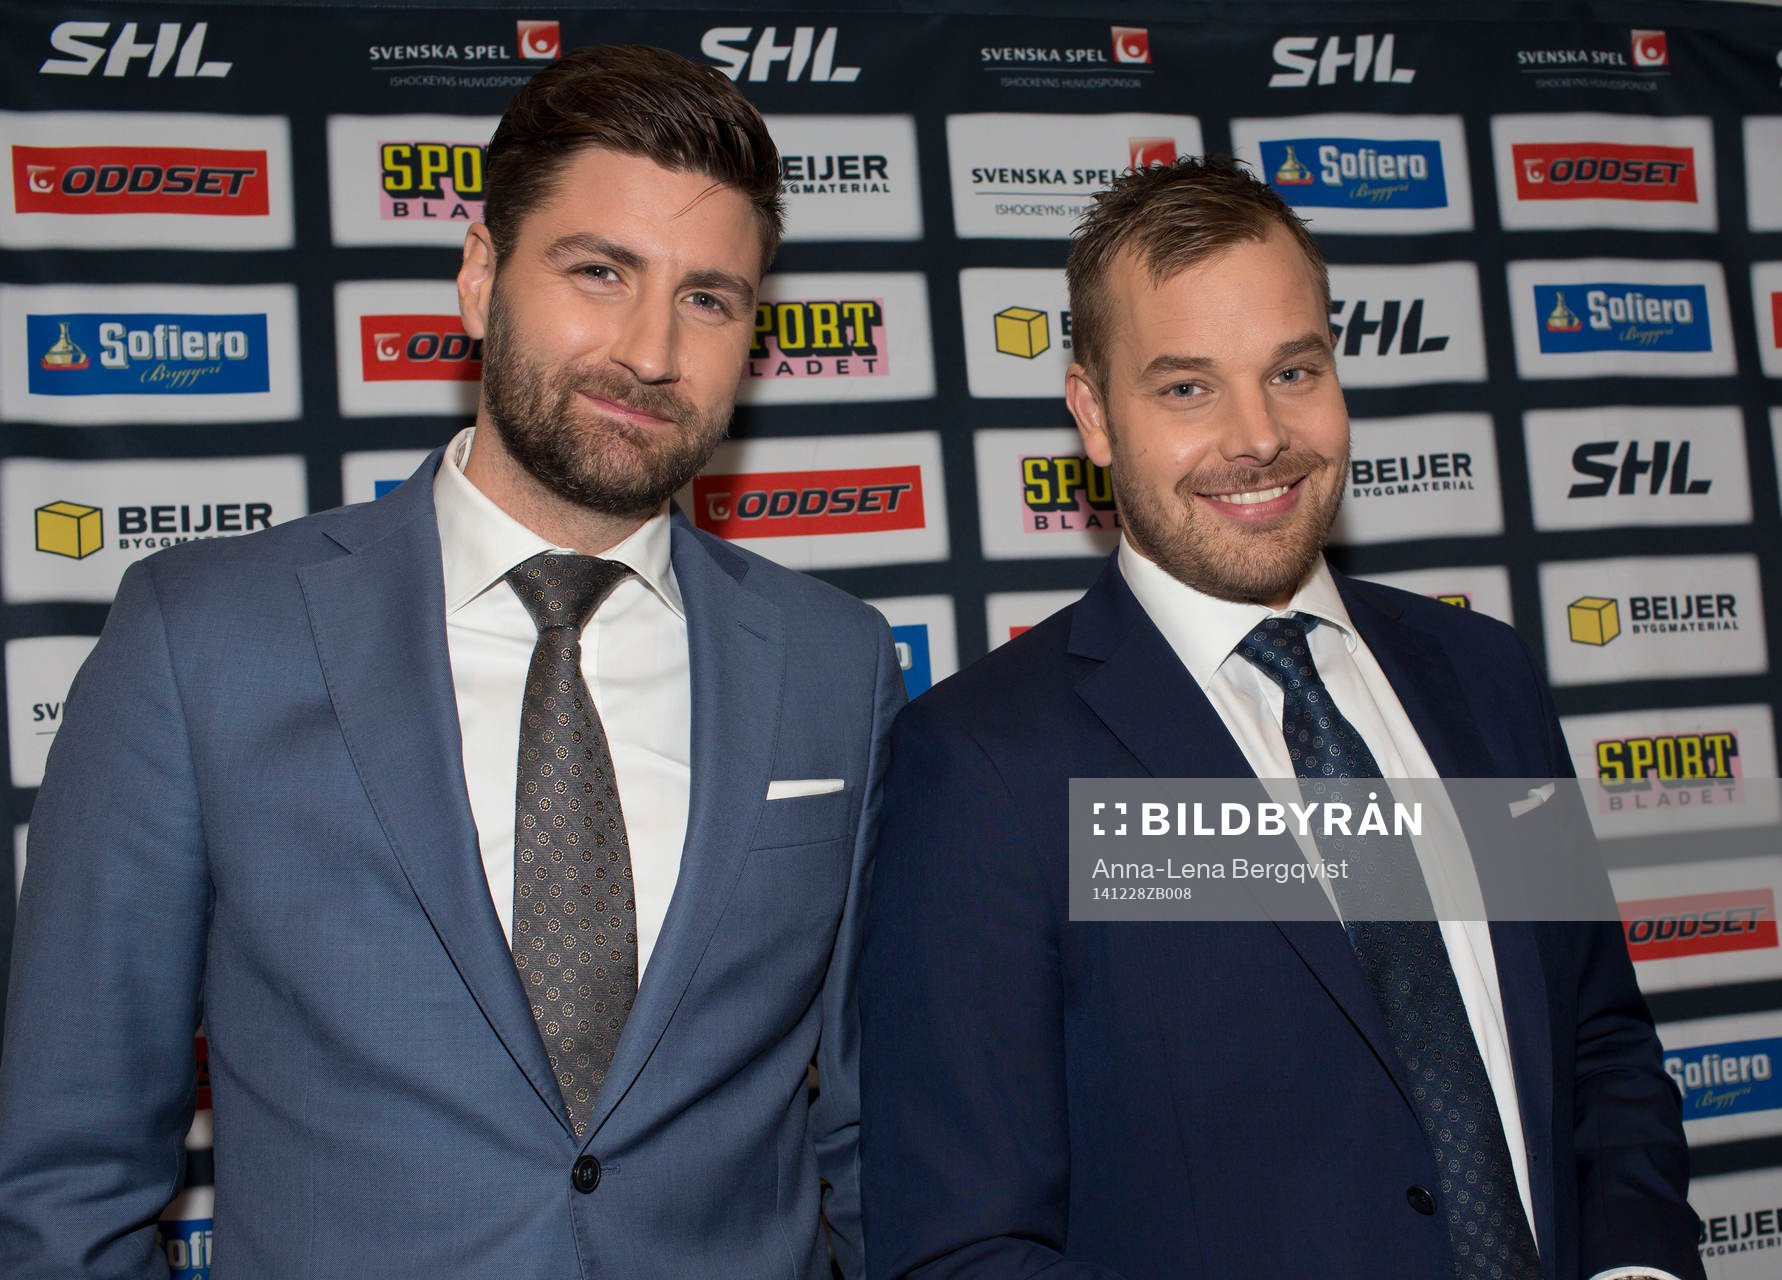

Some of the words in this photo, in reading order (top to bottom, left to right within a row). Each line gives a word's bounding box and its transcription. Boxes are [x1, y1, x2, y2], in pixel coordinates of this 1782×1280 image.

[39, 21, 233, 78] SHL
[369, 44, 459, 60] SVENSKA
[464, 45, 511, 60] SPEL
[701, 26, 862, 82] SHL
[981, 48, 1061, 62] SVENSKA
[1065, 49, 1107, 63] SPEL
[1268, 34, 1416, 88] SHL
[1517, 50, 1591, 64] SVENSKA
[1593, 51, 1627, 65] SPEL
[60, 164, 257, 197] ODDSET
[381, 142, 487, 201] SPO
[781, 154, 889, 181] EIJER
[971, 168, 1066, 184] SVENSKA
[1318, 145, 1429, 186] Sofiero
[1550, 156, 1687, 186] ODDSET
[393, 201, 486, 219] BLA
[1587, 290, 1693, 331] Sofiero
[99, 322, 248, 370] Sofiero
[752, 301, 882, 359] PORT
[750, 359, 878, 377] LADET
[1022, 456, 1116, 512] SPO
[1351, 453, 1473, 485] BEIJER
[1567, 440, 1712, 498] SHL
[736, 484, 912, 521] ODDSET
[1353, 480, 1475, 498] BYGGMATERIAL
[118, 502, 273, 535] BEIJER
[1629, 594, 1737, 621] BEIJER
[1632, 621, 1739, 634] BYGGMATERIAL
[1597, 733, 1738, 794] SPORT
[1609, 787, 1736, 811] BLADET
[1628, 905, 1768, 945] ODDSET
[1664, 1053, 1773, 1099] Sofiero
[1699, 1208, 1782, 1245] EIJE
